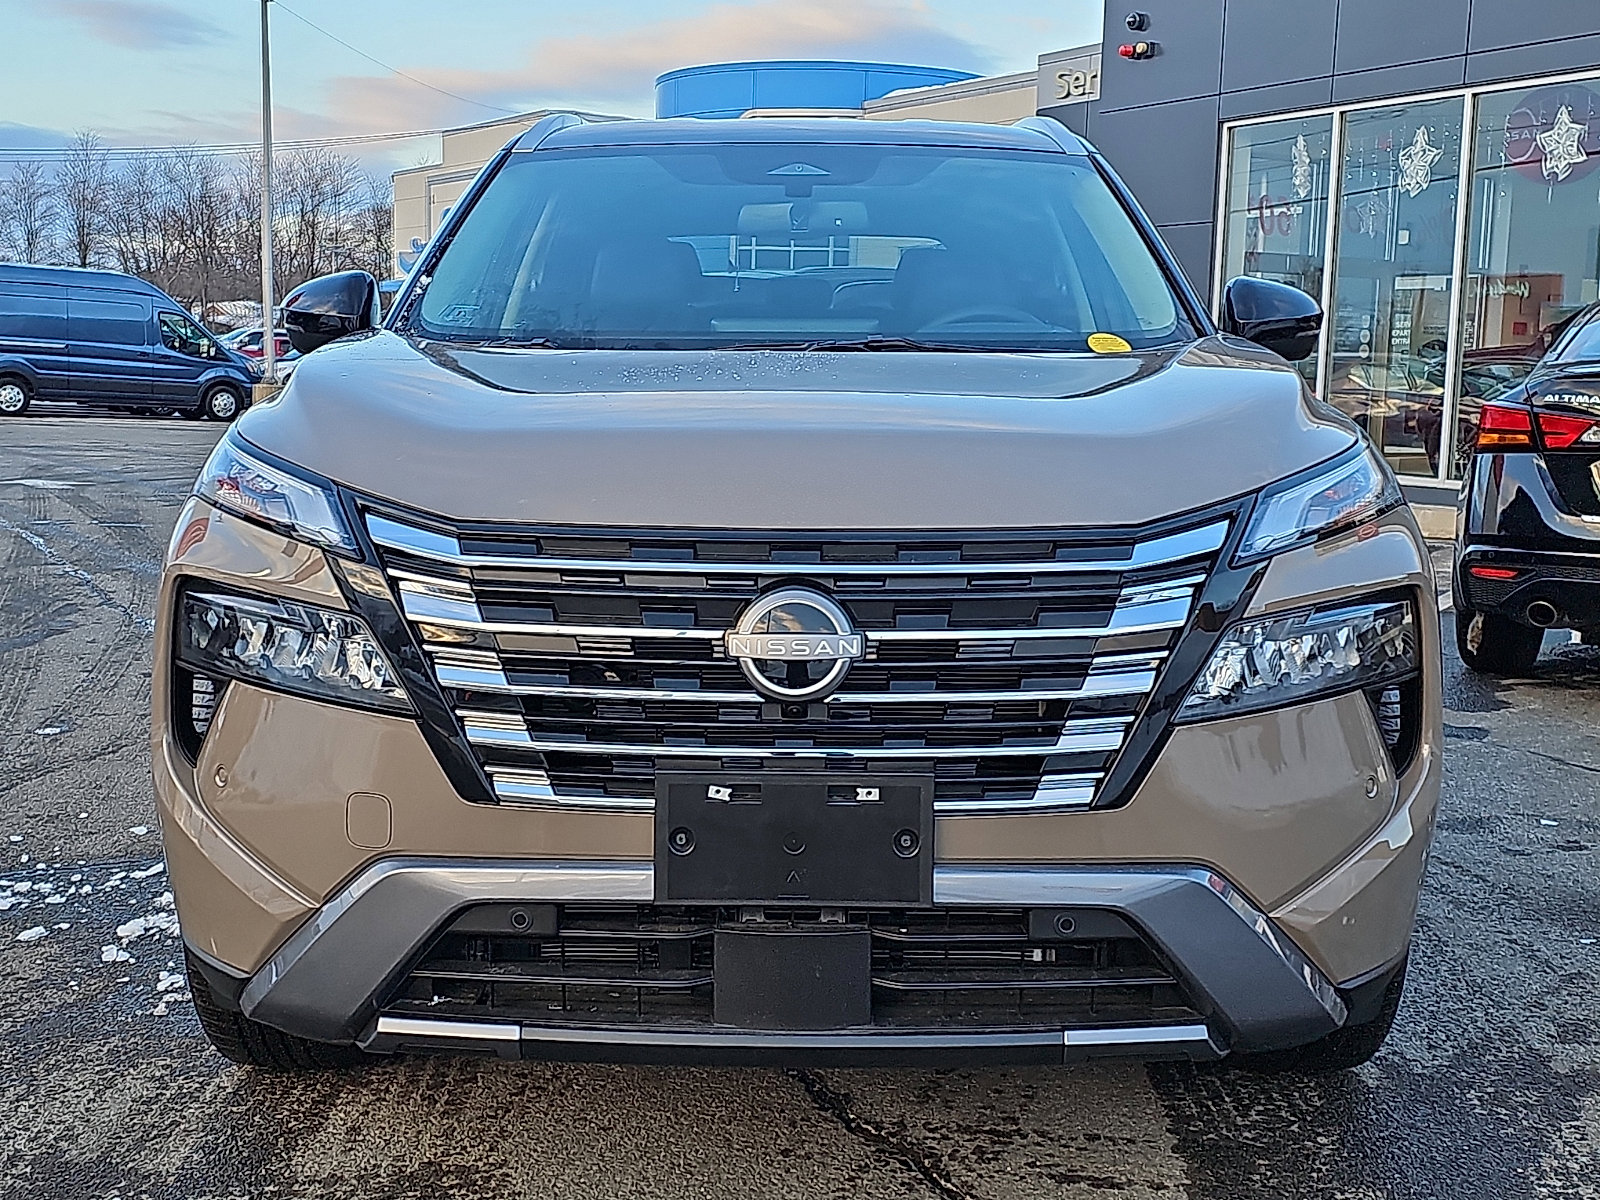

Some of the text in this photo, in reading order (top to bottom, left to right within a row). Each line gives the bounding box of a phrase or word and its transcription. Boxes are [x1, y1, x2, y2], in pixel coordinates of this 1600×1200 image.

[1055, 69, 1098, 100] Ser
[1543, 394, 1600, 404] ALTIMA
[732, 639, 859, 656] NISSAN
